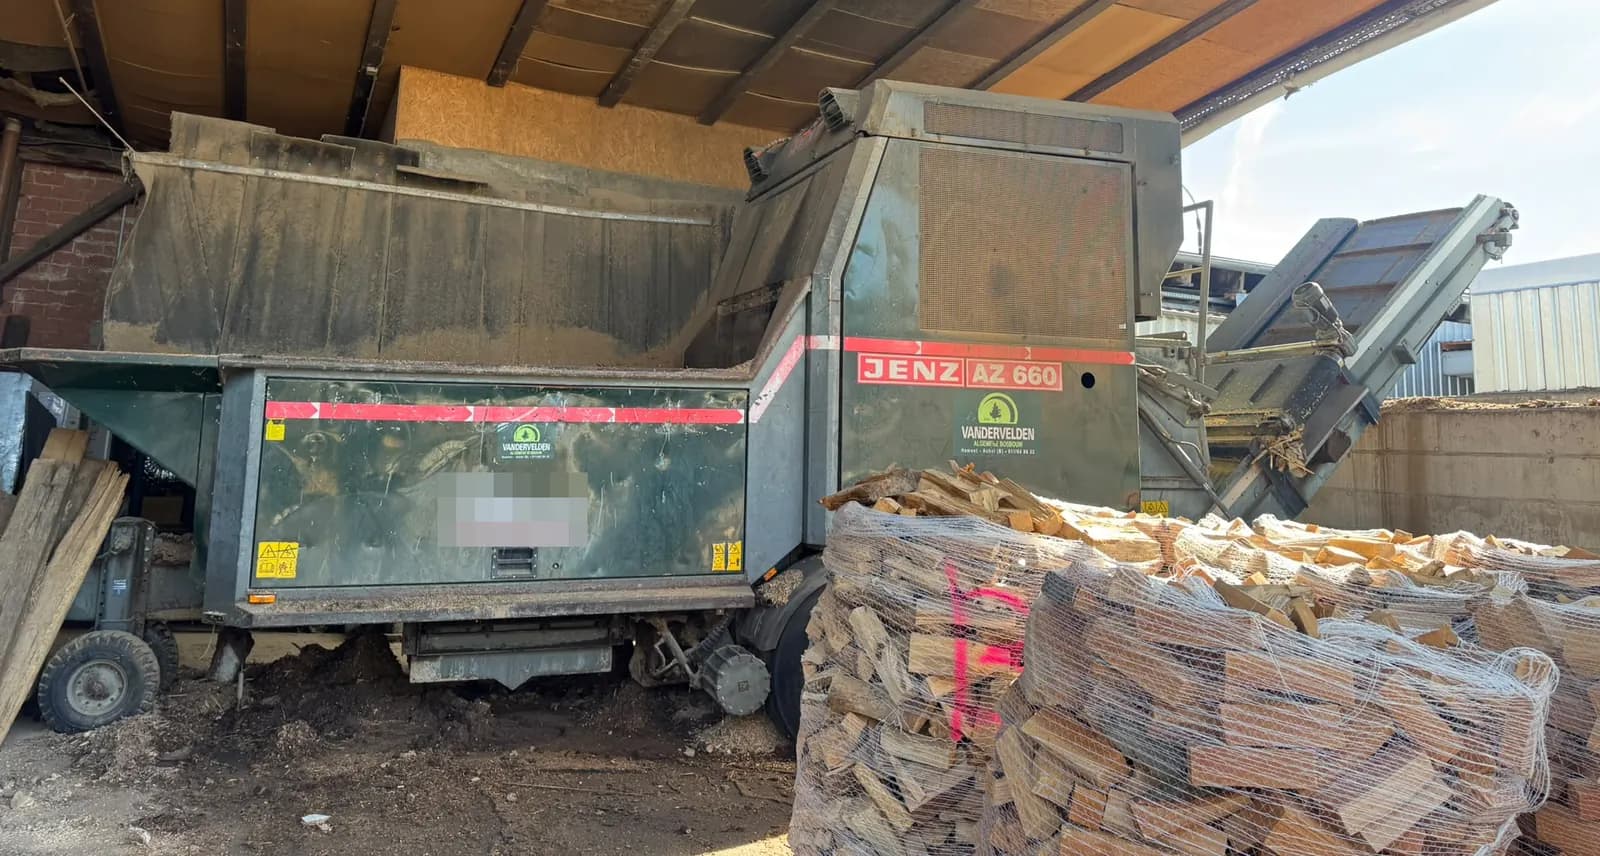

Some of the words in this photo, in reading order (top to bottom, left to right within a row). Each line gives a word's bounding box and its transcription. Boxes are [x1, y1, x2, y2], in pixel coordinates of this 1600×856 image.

[863, 358, 960, 382] JENZ
[972, 363, 1005, 384] AZ
[1012, 364, 1057, 386] 660
[961, 426, 1035, 441] VANDERVELDEN
[502, 442, 551, 451] VANDERVELDEN
